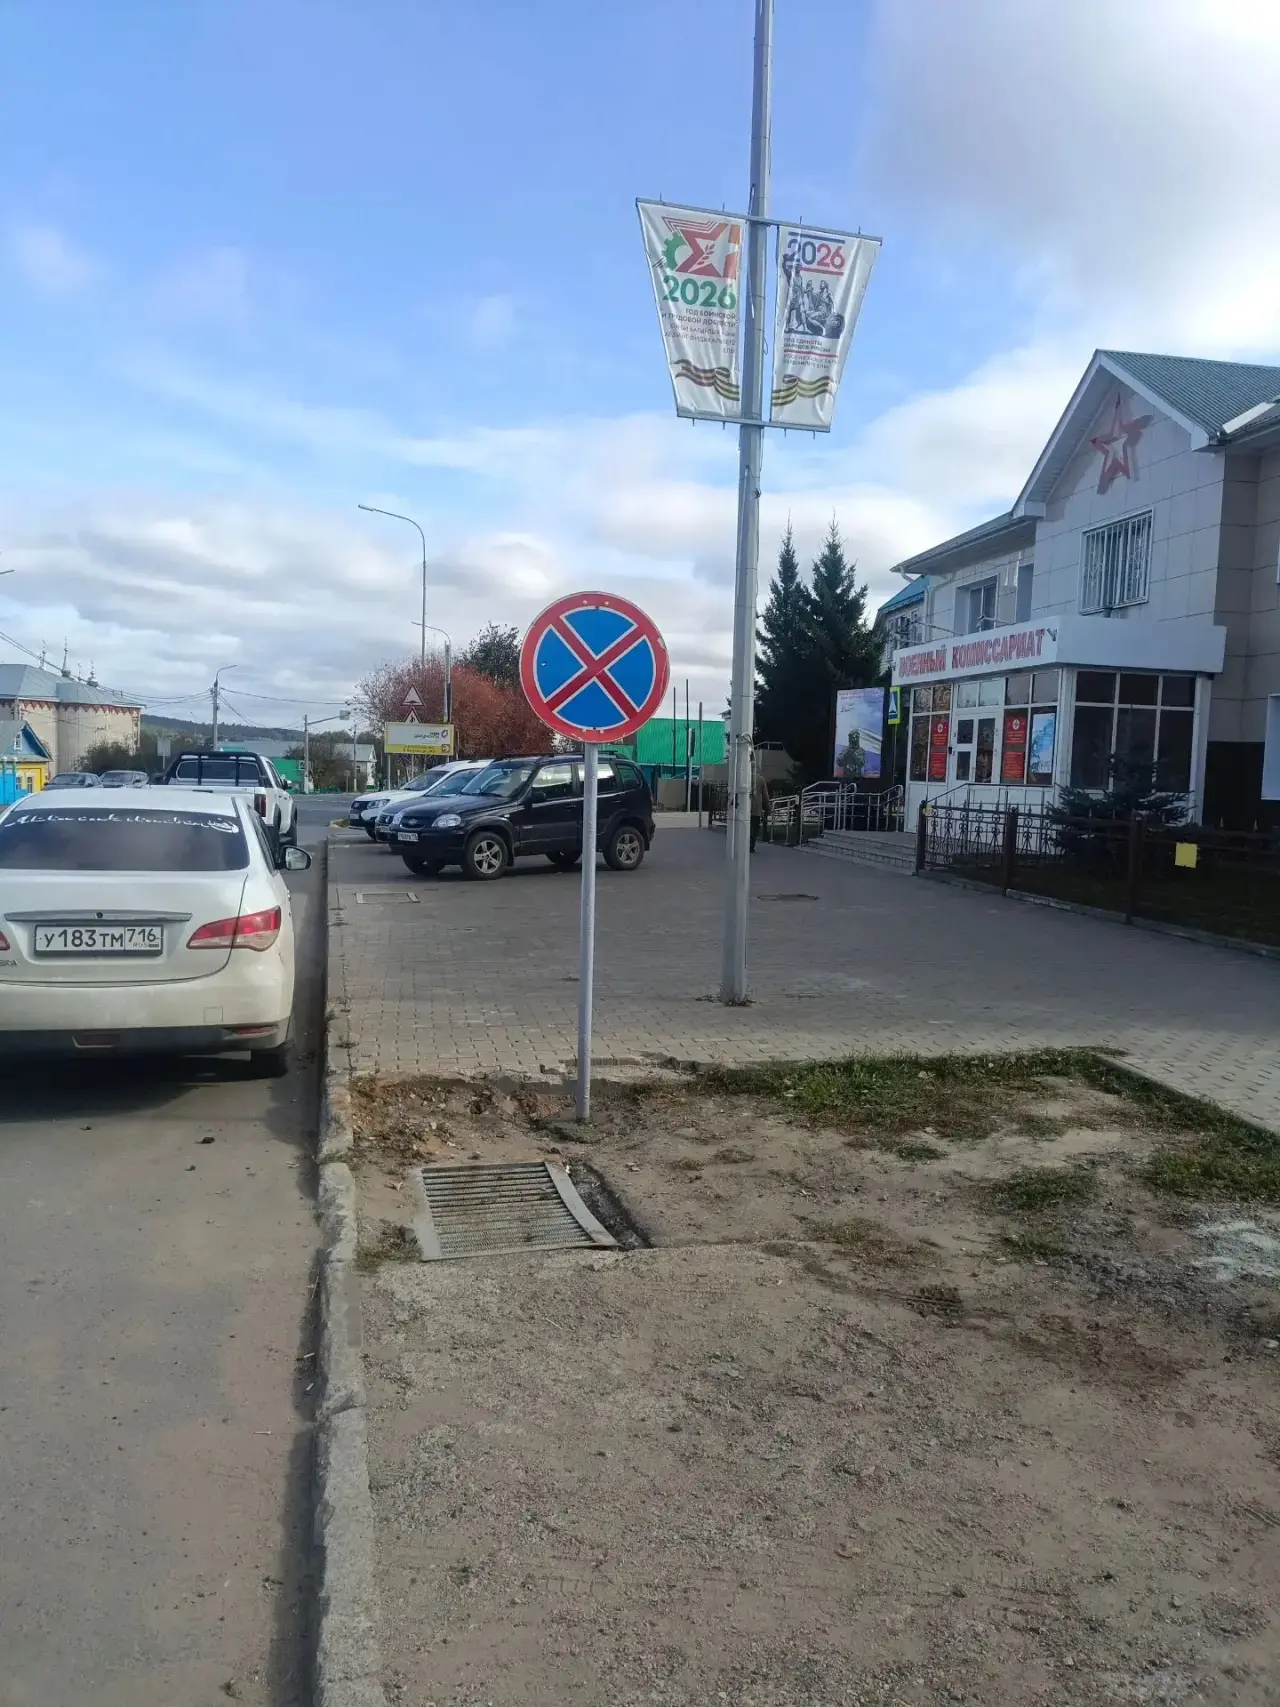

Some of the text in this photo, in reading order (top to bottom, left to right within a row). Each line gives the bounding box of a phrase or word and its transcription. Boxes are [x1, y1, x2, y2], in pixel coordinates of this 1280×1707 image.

[787, 238, 845, 270] 2026
[662, 274, 737, 310] 2026
[685, 308, 698, 316] ГОД
[899, 628, 1046, 678] ВОЕННЫЙ КОМИССАРИАТ
[126, 928, 157, 943] 716
